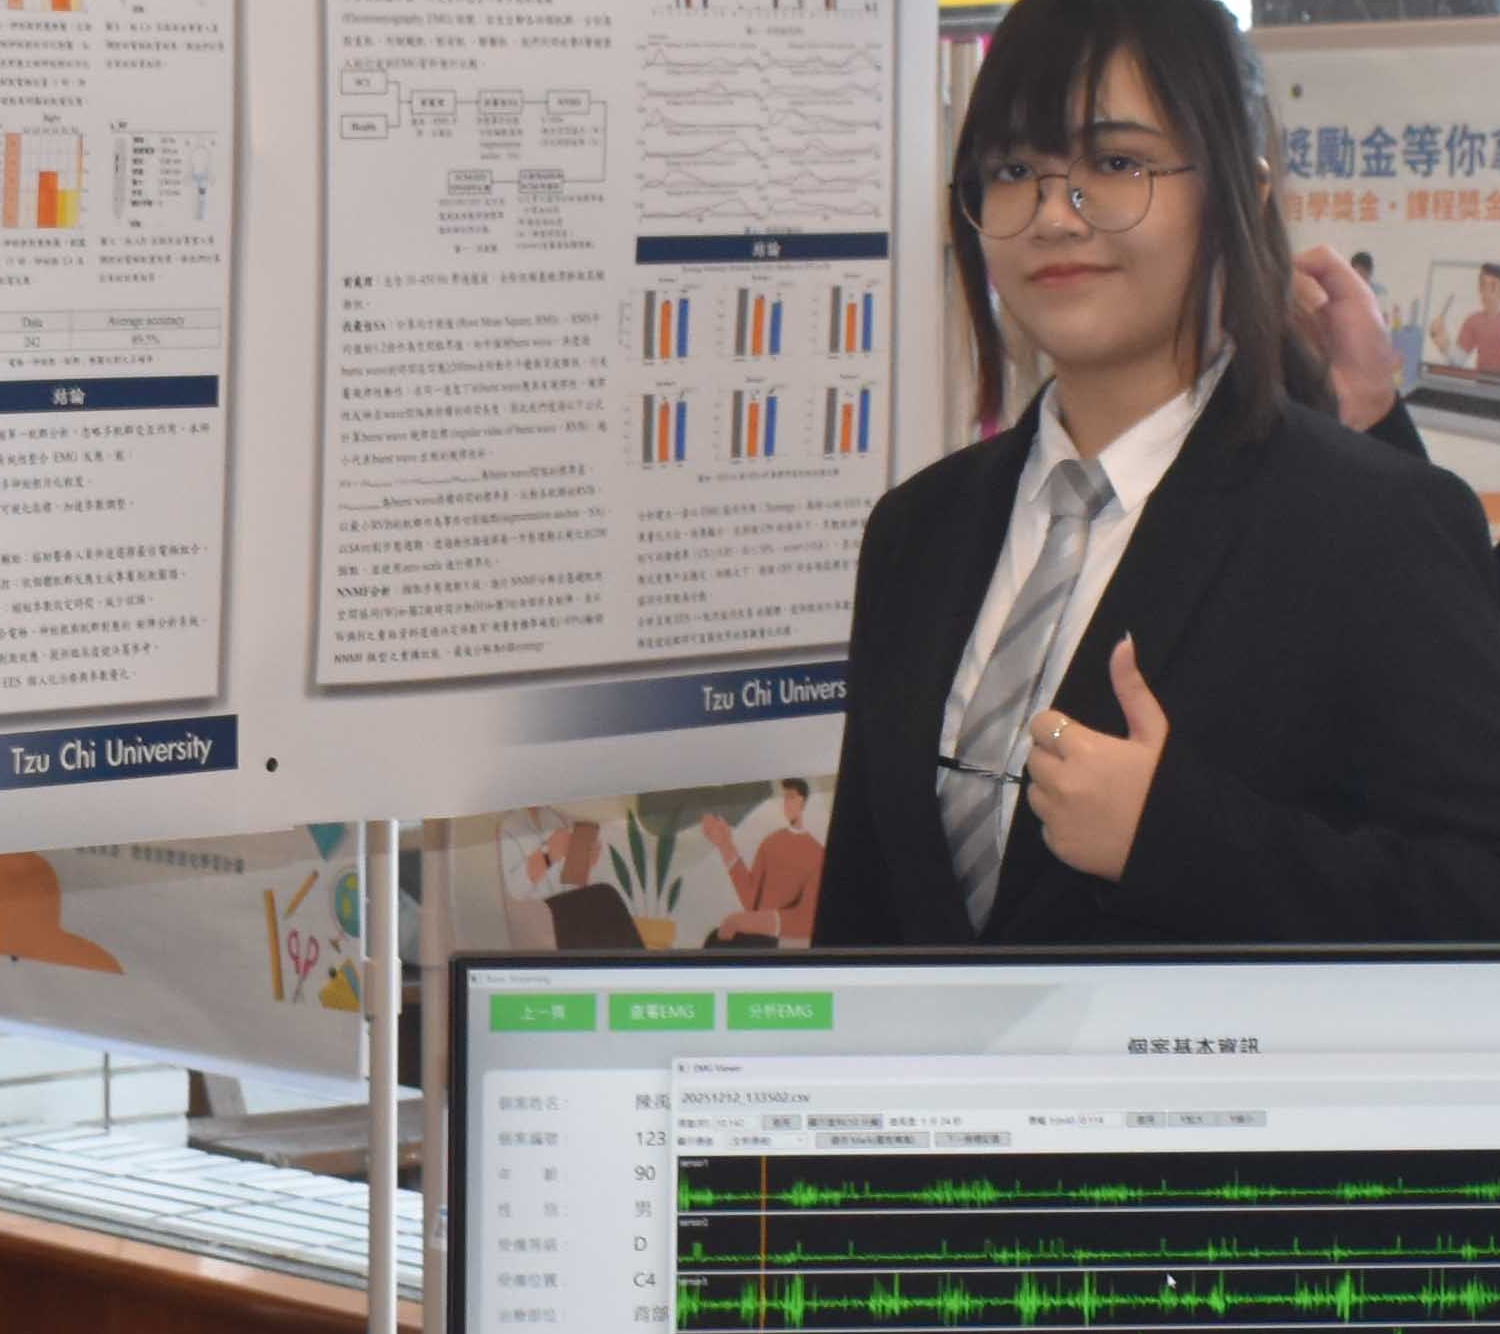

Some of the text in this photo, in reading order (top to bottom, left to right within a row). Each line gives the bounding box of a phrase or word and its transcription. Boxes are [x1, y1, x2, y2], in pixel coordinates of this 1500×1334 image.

[51, 386, 87, 407] 結論
[703, 677, 848, 713] Tzu Chi Univers
[11, 733, 213, 775] Tzu Chi University
[636, 1132, 667, 1147] 123
[634, 1166, 657, 1182] 90
[634, 1236, 648, 1252] D
[633, 1273, 657, 1287] C4
